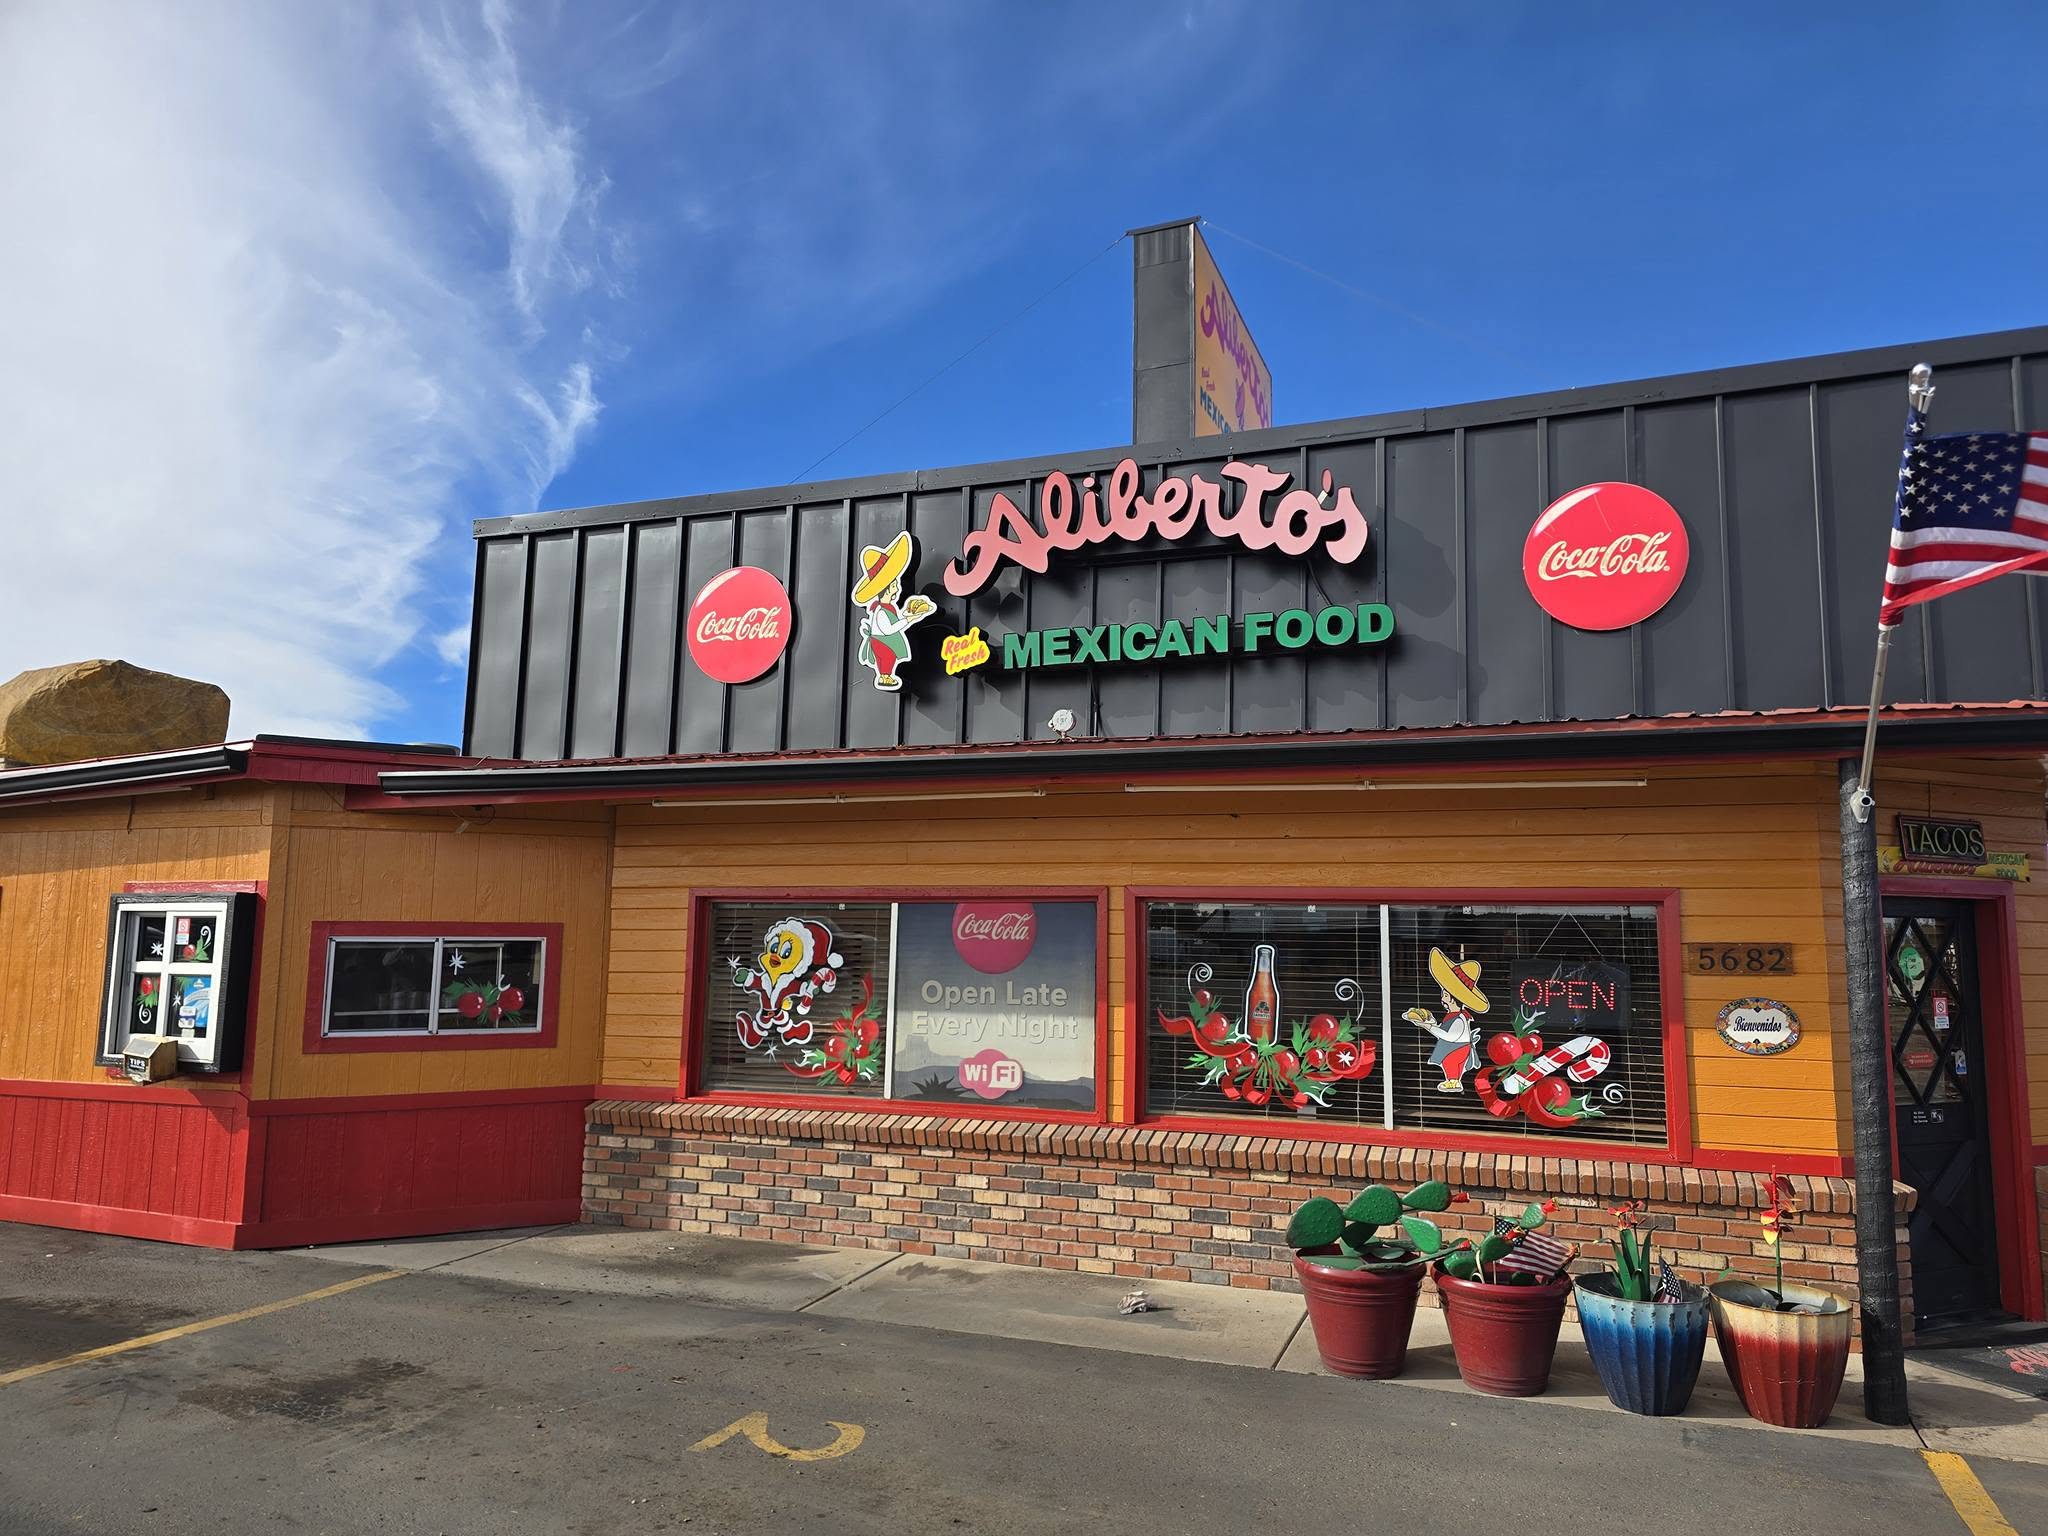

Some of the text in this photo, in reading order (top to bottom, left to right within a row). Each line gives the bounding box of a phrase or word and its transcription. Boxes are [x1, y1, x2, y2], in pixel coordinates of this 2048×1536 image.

[943, 458, 1368, 597] Aliberto's
[1538, 531, 1672, 581] Coca-Cola
[696, 606, 782, 643] Coca-Cola
[1003, 603, 1396, 670] MEXICAN FOOD
[945, 631, 976, 657] Real
[949, 644, 986, 671] Fresh
[1903, 823, 1985, 857] TACOS
[957, 913, 1033, 941] Coca-Cola
[1699, 947, 1786, 971] 5682
[921, 980, 1068, 1009] Open Late
[1520, 978, 1615, 1011] OPEN
[911, 1010, 1079, 1044] Every Night
[1733, 1016, 1782, 1032] Bienvenidos
[130, 1058, 145, 1067] TIPS
